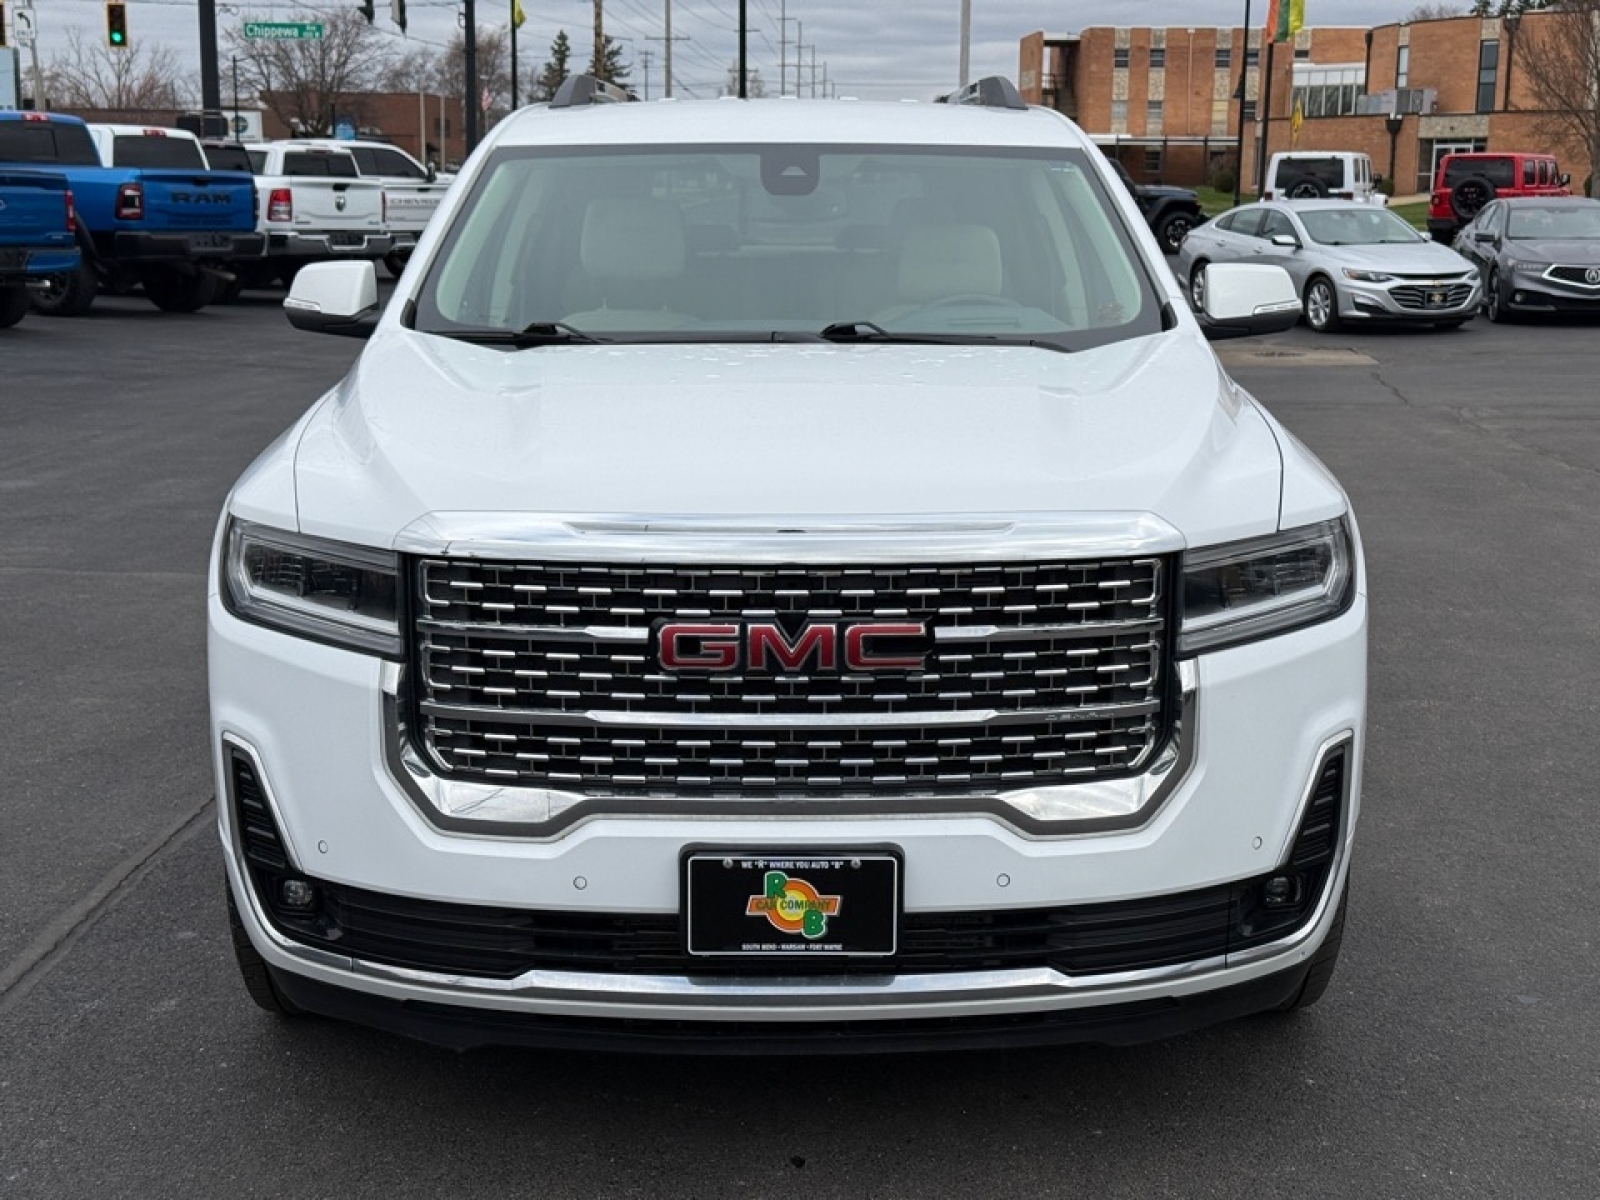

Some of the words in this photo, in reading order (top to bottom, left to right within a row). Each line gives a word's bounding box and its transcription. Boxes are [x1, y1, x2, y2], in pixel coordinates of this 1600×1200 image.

[246, 25, 299, 37] Chippewa
[170, 192, 231, 204] RAM
[389, 198, 440, 206] CHEVRO
[658, 622, 926, 671] GMC
[741, 861, 753, 869] WE
[769, 861, 795, 869] WHERE
[796, 861, 810, 869] YOU
[811, 861, 829, 869] AUTO
[764, 871, 788, 899] R
[757, 900, 777, 910] CAR
[780, 900, 830, 910] COMPANY
[802, 910, 826, 938] B
